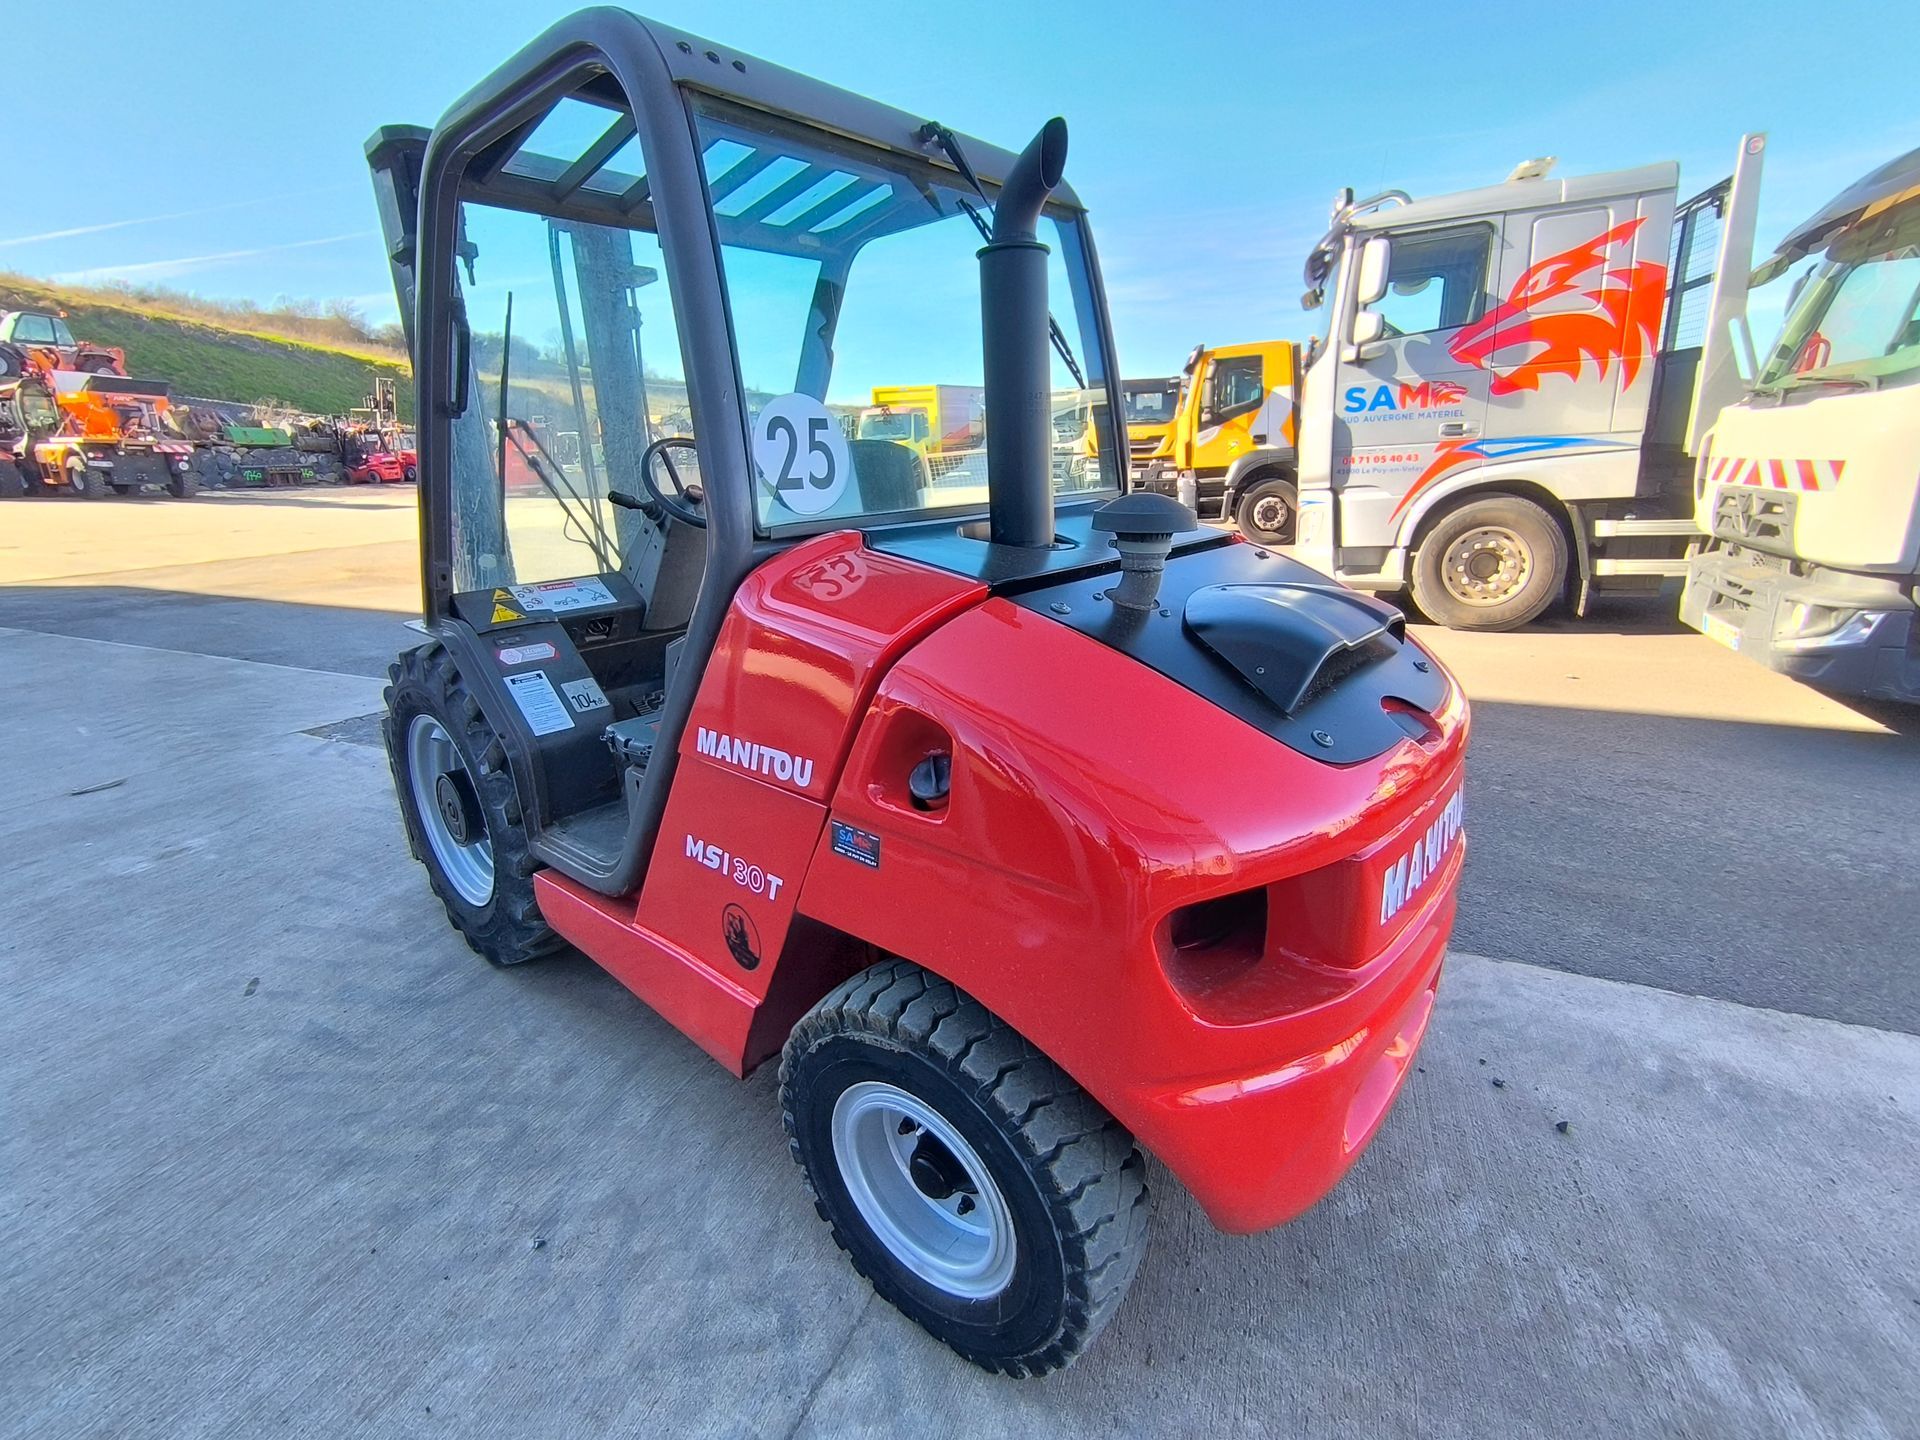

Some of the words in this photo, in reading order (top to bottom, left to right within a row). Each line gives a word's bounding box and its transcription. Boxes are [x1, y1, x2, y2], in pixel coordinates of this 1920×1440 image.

[1344, 381, 1430, 413] SAM
[1342, 416, 1360, 424] SUD
[1363, 412, 1415, 423] AUVERGNE
[1417, 409, 1465, 420] MATERIEL
[766, 415, 836, 490] 25
[1358, 455, 1370, 464] 71
[1374, 455, 1386, 464] 05
[1389, 454, 1403, 463] 40
[1406, 453, 1419, 462] 43
[571, 693, 598, 709] 104
[697, 727, 813, 787] MANITOU
[1380, 777, 1464, 926] MANITOU
